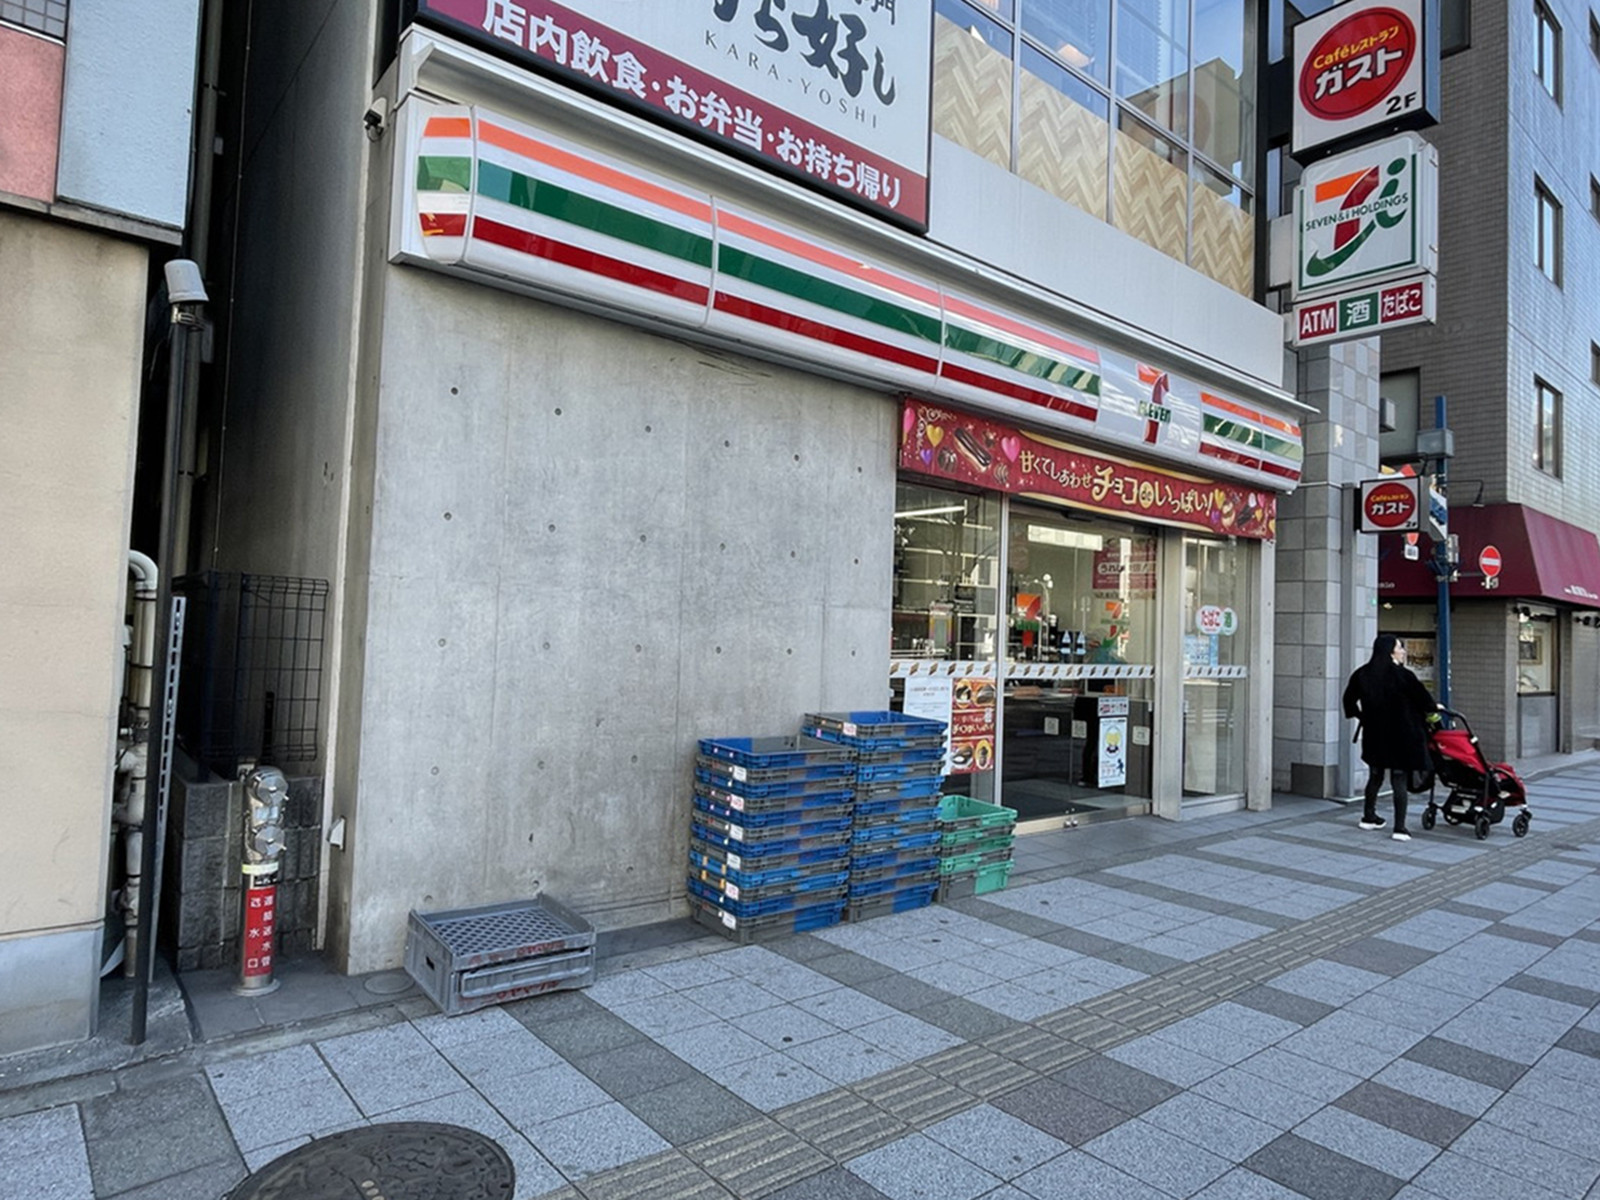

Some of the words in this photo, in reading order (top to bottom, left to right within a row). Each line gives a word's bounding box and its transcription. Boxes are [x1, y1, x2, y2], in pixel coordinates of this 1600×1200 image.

[713, 0, 896, 106] ら好し
[1314, 47, 1403, 101] ガスト
[704, 29, 877, 129] KARA-YOSHI
[1385, 91, 1417, 116] 2F
[1351, 192, 1409, 218] HOLDINGS
[1301, 306, 1335, 336] ATM
[1346, 298, 1371, 327] 酒
[1382, 287, 1422, 318] たばこ
[1371, 501, 1410, 516] ガスト
